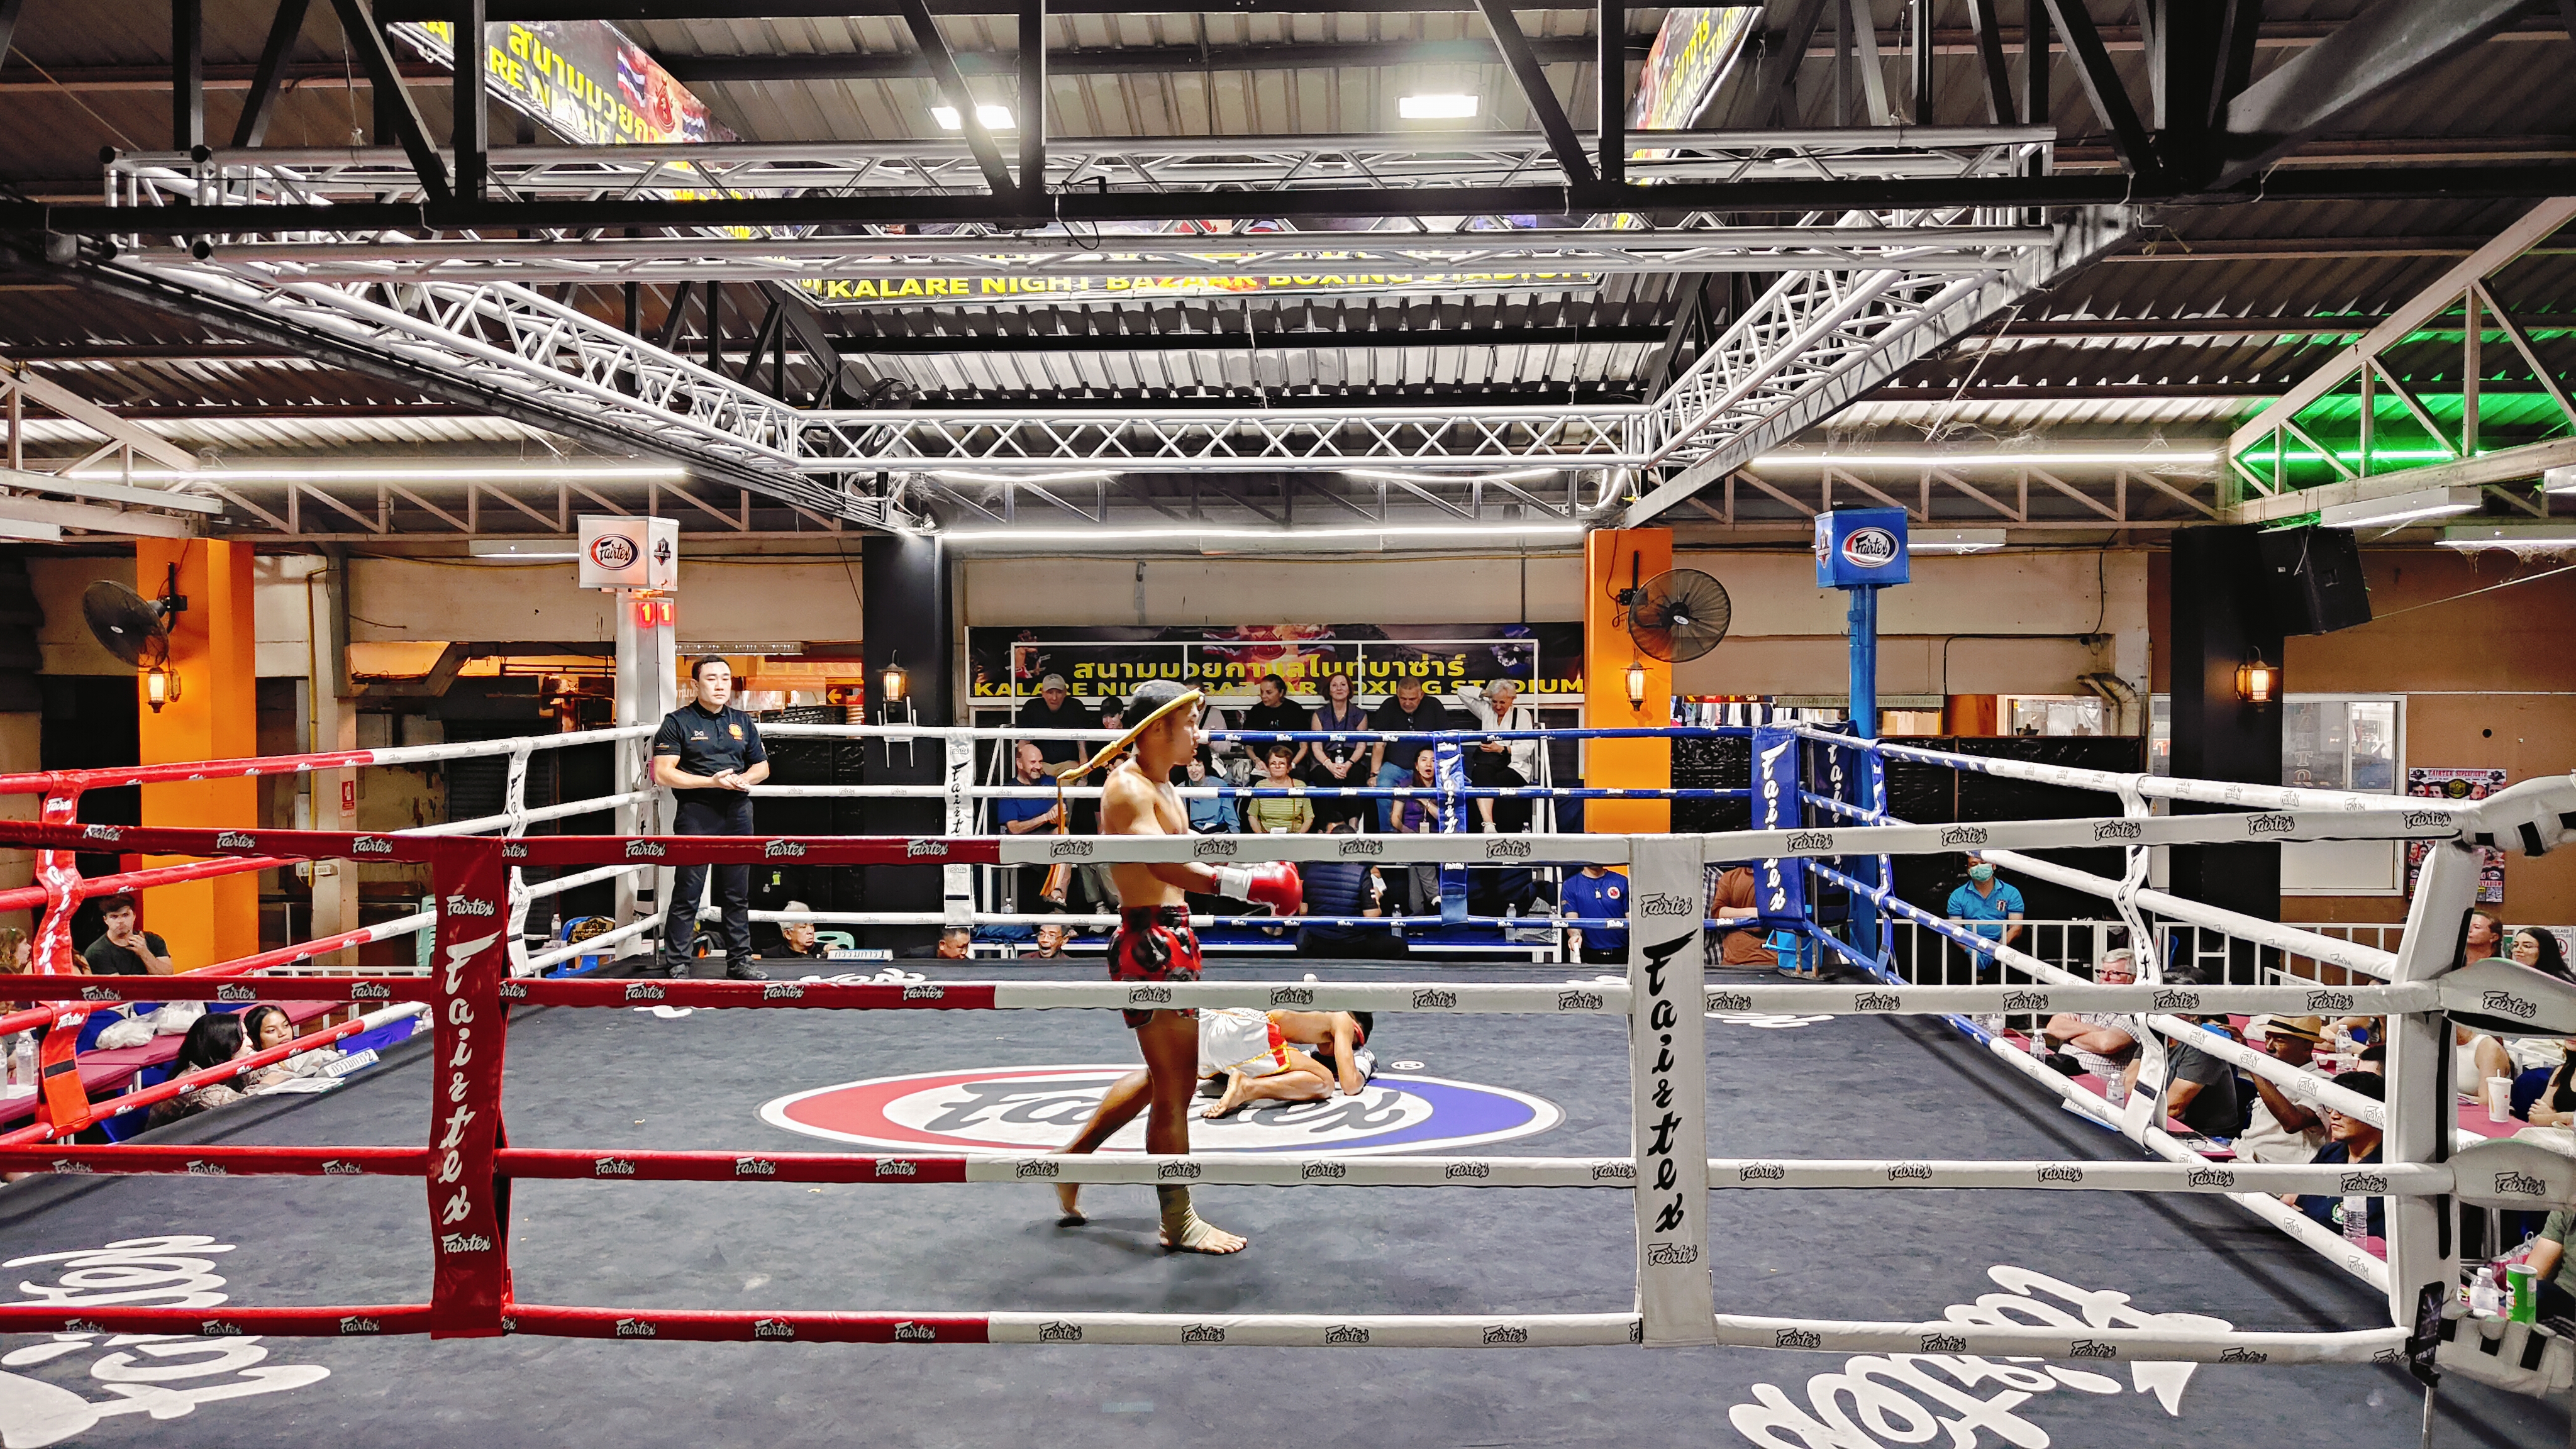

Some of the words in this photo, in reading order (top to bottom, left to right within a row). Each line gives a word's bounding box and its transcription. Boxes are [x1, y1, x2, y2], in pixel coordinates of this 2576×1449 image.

[827, 278, 969, 297] KALARE
[980, 277, 1089, 293] NIGHT
[600, 539, 631, 562] Fairtex
[1855, 534, 1888, 556] Fairtex
[2248, 815, 2295, 835] Fairtex
[2404, 811, 2451, 828] Fairtex
[217, 832, 255, 848] Fairtex
[1941, 826, 1987, 846] Fairtex
[2094, 821, 2141, 840] Fairtex
[353, 836, 392, 853] Fairtex
[626, 839, 665, 857] Fairtex
[765, 840, 806, 857] Fairtex
[908, 840, 948, 857] Fairtex
[1050, 840, 1093, 857] Fairtex
[1194, 839, 1238, 856] Fairtex
[1339, 838, 1383, 857] Fairtex
[1487, 839, 1531, 857] Fairtex
[1787, 832, 1833, 852] Fairtex
[447, 895, 494, 916] Fairtex
[1640, 893, 1692, 918] Fairtex
[82, 985, 121, 1001] Fairtex
[217, 983, 256, 1000] Fairtex
[351, 981, 391, 998] Fairtex
[625, 982, 665, 1000] Fairtex
[764, 984, 804, 1000] Fairtex
[903, 984, 944, 1000] Fairtex
[1129, 985, 1171, 1003] Fairtex
[1271, 985, 1313, 1004] Fairtex
[1413, 989, 1457, 1008] Fairtex
[1558, 991, 1602, 1010] Fairtex
[1706, 992, 1752, 1011] Fairtex
[1855, 992, 1900, 1011] Fairtex
[2003, 991, 2048, 1010] Fairtex
[2153, 990, 2199, 1009] Fairtex
[2307, 990, 2353, 1010] Fairtex
[2483, 991, 2536, 1018] Fairtex
[438, 930, 501, 1225] Fairtex
[1641, 929, 1698, 1233] Fairtex
[52, 1159, 93, 1174] Fairtex
[186, 1160, 226, 1175] Fairtex
[322, 1160, 362, 1175] Fairtex
[596, 1157, 635, 1175] Fairtex
[736, 1157, 775, 1176] Fairtex
[875, 1158, 916, 1177] Fairtex
[1016, 1158, 1058, 1178] Fairtex
[1158, 1160, 1201, 1179] Fairtex
[1302, 1160, 1345, 1179] Fairtex
[1446, 1160, 1489, 1179] Fairtex
[1592, 1161, 1636, 1179] Fairtex
[1740, 1163, 1784, 1181] Fairtex
[1887, 1163, 1932, 1181] Fairtex
[2038, 1163, 2082, 1182] Fairtex
[2189, 1167, 2235, 1188] Fairtex
[2341, 1173, 2387, 1193] Fairtex
[2495, 1172, 2545, 1196] Fairtex
[442, 1232, 491, 1254] Fairtex
[1648, 1243, 1697, 1266] Fairtex
[65, 1318, 105, 1334] Fairtex
[202, 1319, 243, 1335] Fairtex
[340, 1316, 380, 1334] Fairtex
[616, 1318, 656, 1336] Fairtex
[755, 1319, 794, 1338] Fairtex
[894, 1321, 935, 1340] Fairtex
[1039, 1321, 1082, 1341] Fairtex
[1182, 1324, 1225, 1343] Fairtex
[1325, 1324, 1369, 1344] Fairtex
[1483, 1324, 1527, 1345] Fairtex
[1776, 1328, 1821, 1349] Fairtex
[1921, 1333, 1967, 1353] Fairtex
[2070, 1340, 2116, 1359] Fairtex
